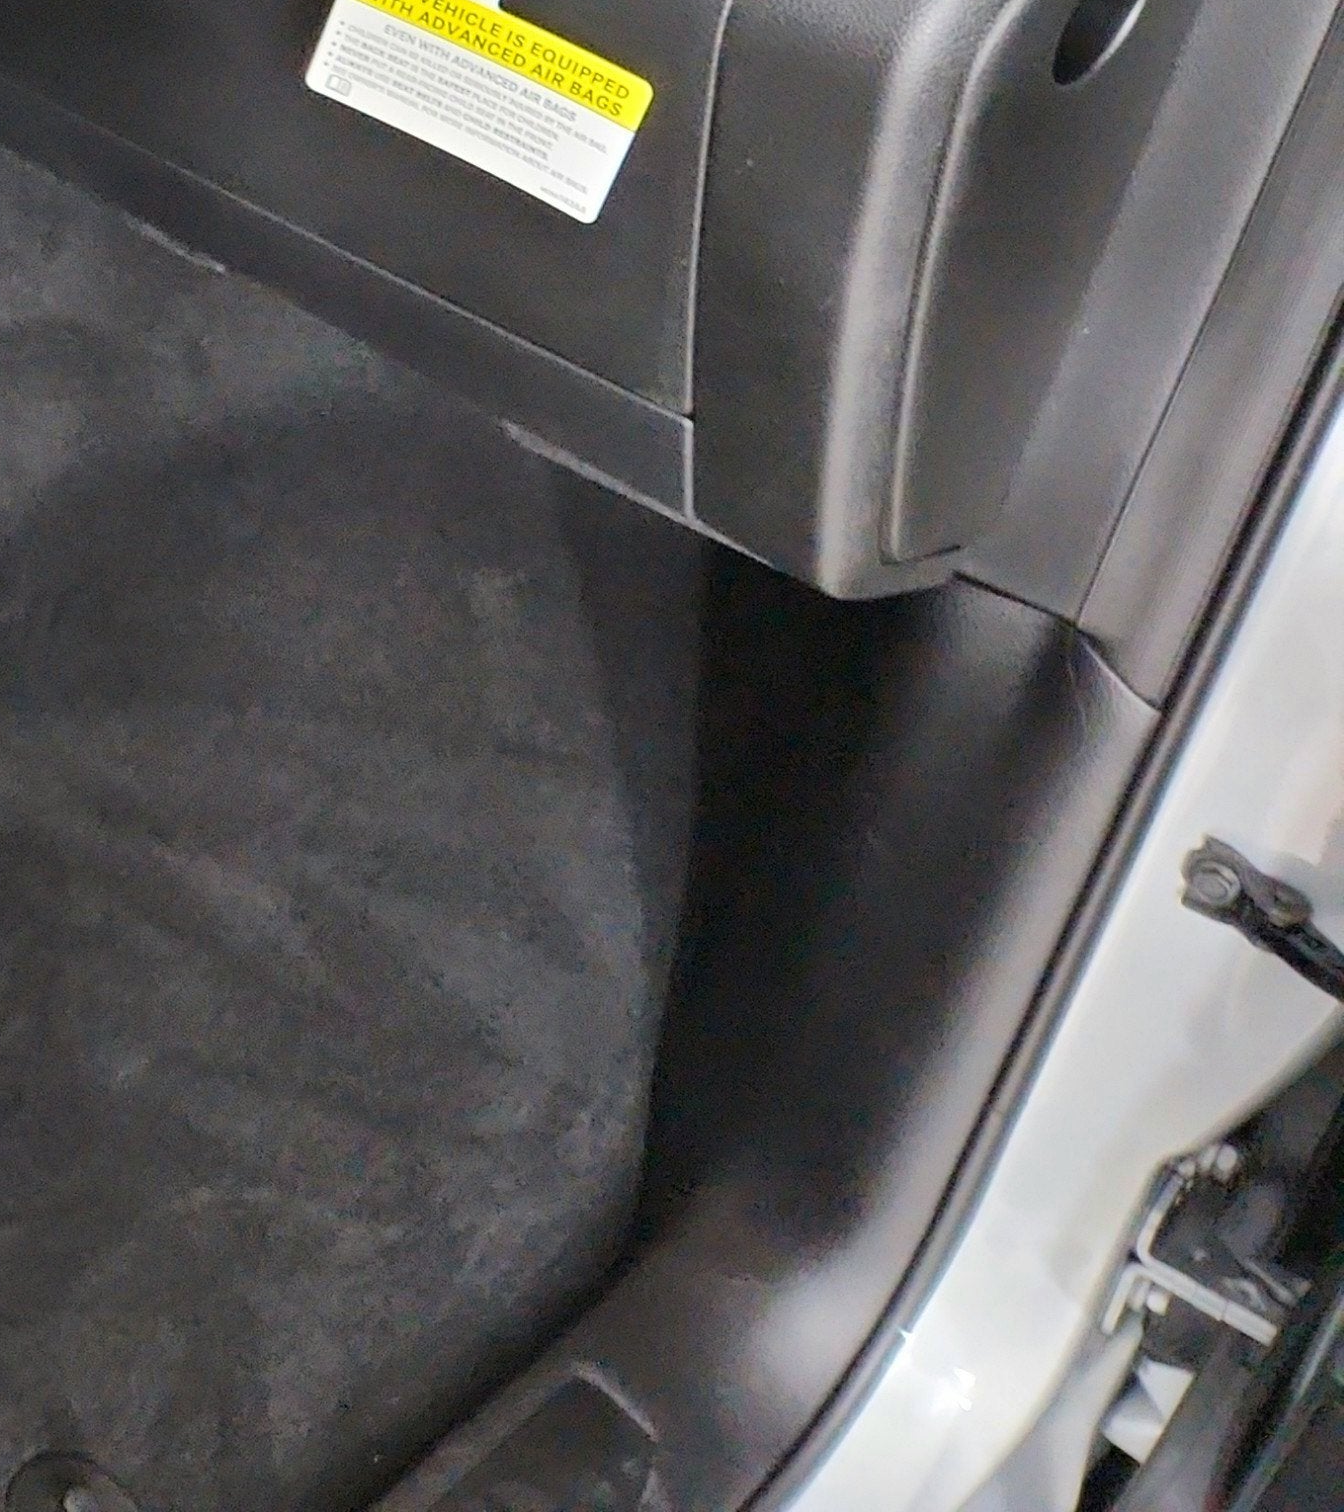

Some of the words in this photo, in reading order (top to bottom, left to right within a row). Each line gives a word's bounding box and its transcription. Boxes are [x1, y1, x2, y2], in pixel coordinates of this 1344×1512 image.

[384, 24, 417, 45] EVEN
[419, 39, 450, 61] WITH
[451, 56, 518, 93] ADVANCED
[520, 87, 542, 105] AIR
[543, 98, 577, 122] BAGS
[418, 11, 526, 67] ADVANCED
[531, 63, 565, 88] AIR
[570, 81, 623, 116] BAGS
[506, 30, 525, 48] IS
[531, 42, 630, 100] EQUIPPED
